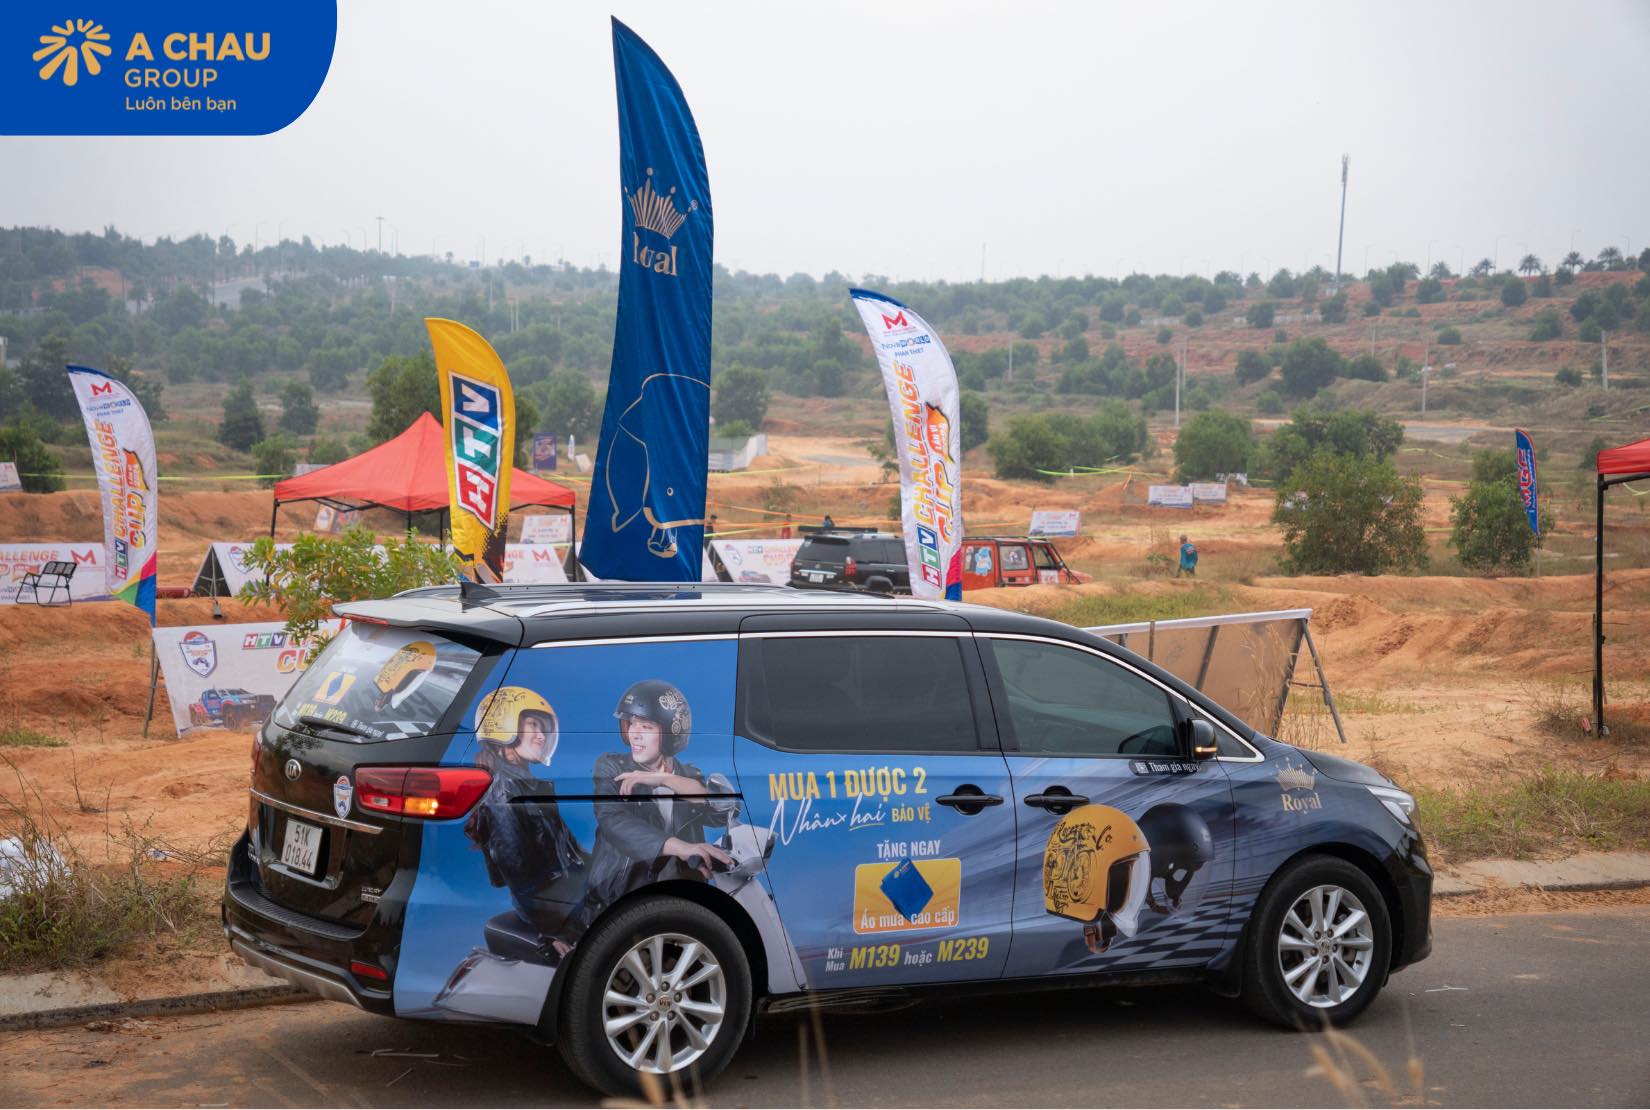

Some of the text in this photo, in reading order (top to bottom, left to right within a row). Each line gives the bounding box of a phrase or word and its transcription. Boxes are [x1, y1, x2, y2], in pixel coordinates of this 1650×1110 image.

[458, 380, 495, 518] HTV
[892, 360, 934, 525] CHALLENGE
[95, 418, 129, 580] HTV CHALLENGE
[127, 491, 147, 550] CUP
[917, 526, 940, 588] HTV
[242, 632, 287, 650] HTV
[768, 766, 928, 802] MUA 1 ĐƯỢC 2
[767, 796, 839, 846] Nhân
[849, 791, 886, 828] hai
[891, 803, 914, 823] BẢO
[917, 802, 932, 825] VỆ
[1280, 792, 1323, 815] Royal
[294, 823, 312, 847] 51K
[284, 843, 314, 870] 018.44
[876, 840, 941, 862] TẶNG NGAY
[860, 908, 876, 929] Áo
[910, 911, 931, 926] cao
[934, 905, 955, 926] cấp
[824, 960, 845, 972] Mua
[827, 947, 843, 960] Khi
[849, 936, 990, 970] M139 hoặc M239
